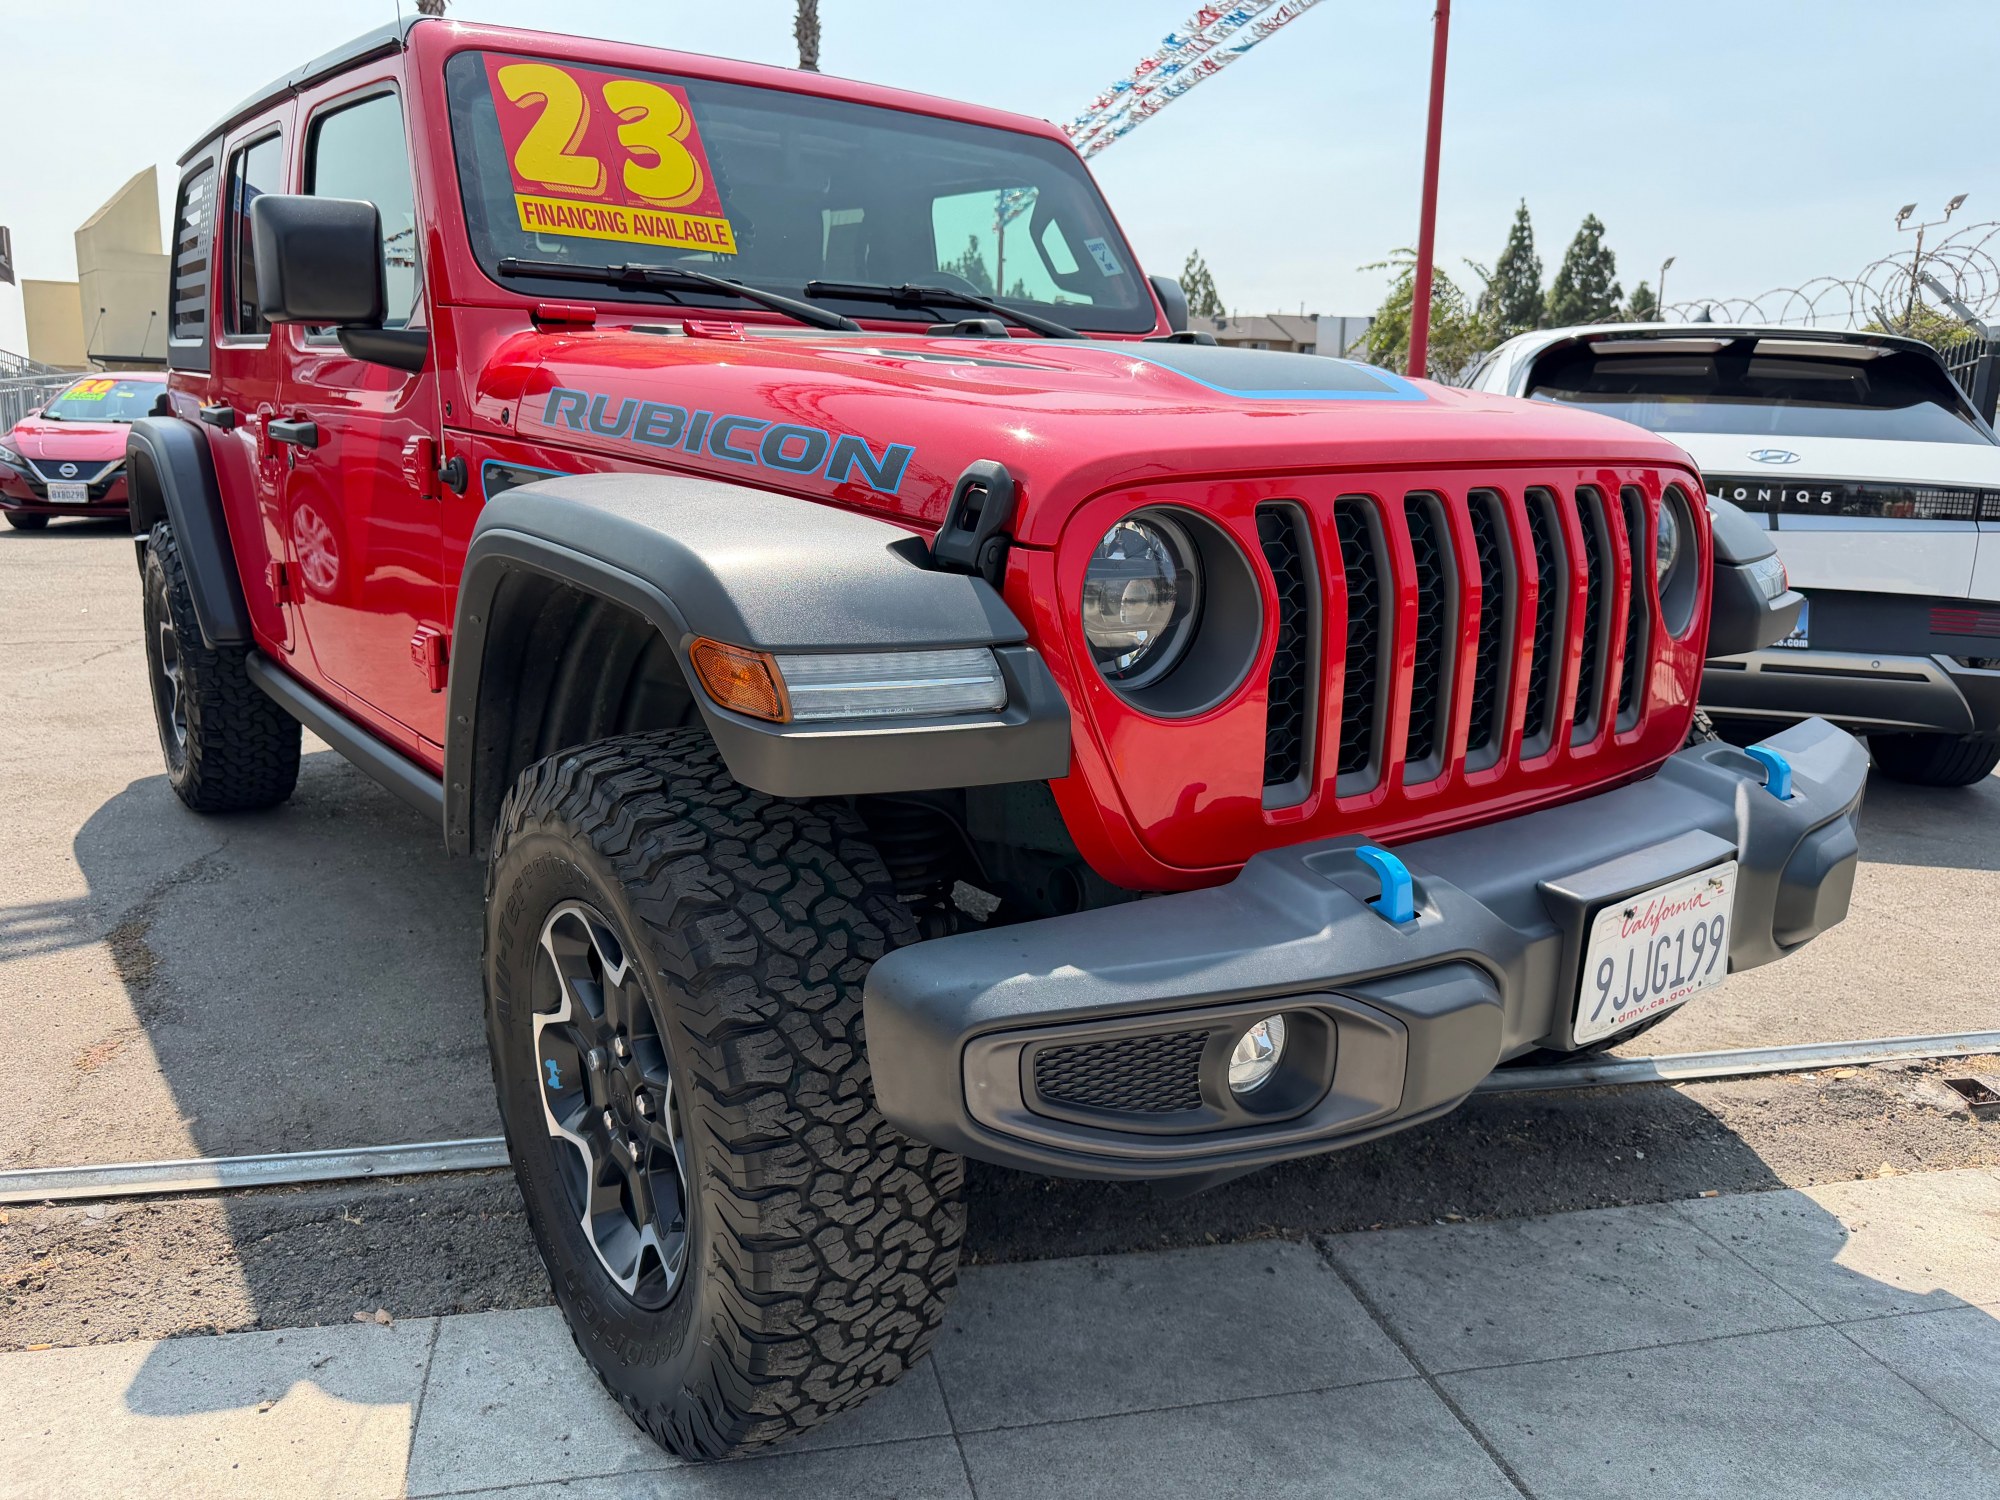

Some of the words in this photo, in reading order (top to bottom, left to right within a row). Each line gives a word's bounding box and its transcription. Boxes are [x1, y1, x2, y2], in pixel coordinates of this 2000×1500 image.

[497, 63, 704, 208] 23
[522, 201, 629, 235] FINANCING
[633, 214, 730, 247] AVAILABLE
[70, 379, 115, 392] 20
[541, 386, 917, 495] RUBICON
[1718, 487, 1810, 504] IONIQ
[1820, 491, 1832, 504] 5
[1621, 888, 1711, 939] California
[1590, 914, 1725, 1022] 9JJG199
[1617, 985, 1694, 1023] dmv.ca.gov
